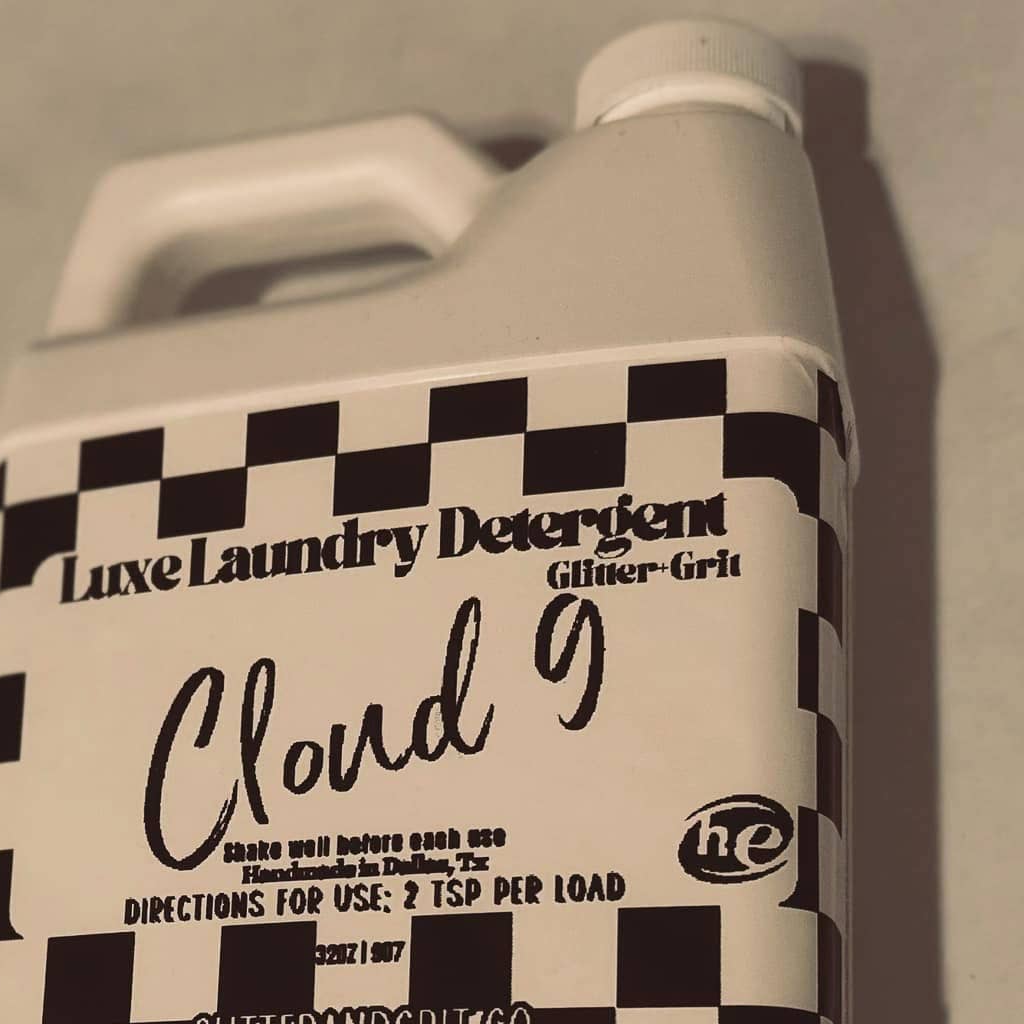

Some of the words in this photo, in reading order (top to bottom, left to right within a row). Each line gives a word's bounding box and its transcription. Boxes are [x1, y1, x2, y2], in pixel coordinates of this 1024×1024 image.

[59, 554, 181, 603] Luxe
[188, 518, 429, 578] Laundry
[436, 492, 728, 560] Detergent
[144, 597, 494, 870] Cloud
[535, 594, 605, 730] 9
[224, 841, 282, 863] Shake
[288, 835, 330, 858] well
[337, 833, 404, 856] before
[409, 828, 461, 851] each
[467, 827, 506, 849] use
[358, 857, 380, 877] in
[456, 852, 490, 872] Tx
[124, 889, 265, 926] DIRECTIONS
[276, 885, 324, 916] FOR
[403, 880, 419, 910] 2
[431, 876, 482, 908] TSP
[495, 875, 544, 905] PER
[554, 871, 626, 903] LOAD
